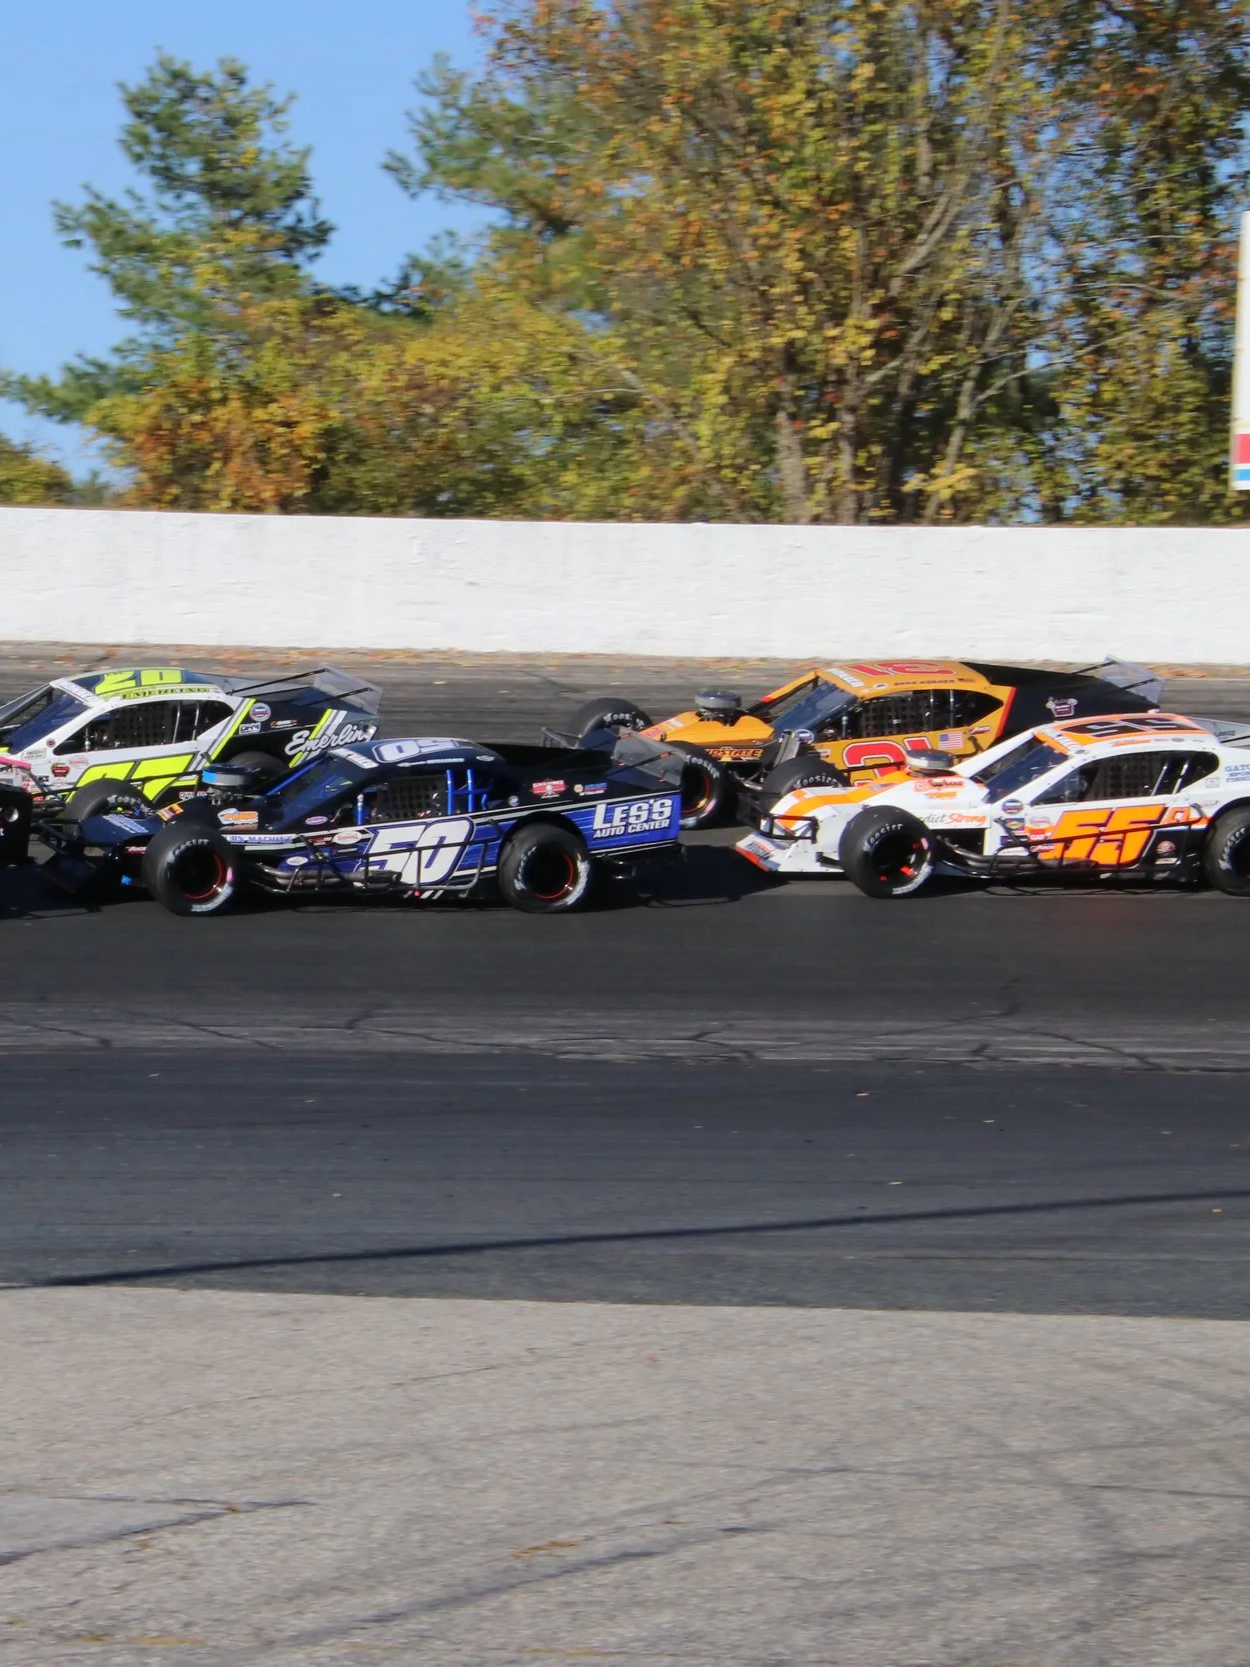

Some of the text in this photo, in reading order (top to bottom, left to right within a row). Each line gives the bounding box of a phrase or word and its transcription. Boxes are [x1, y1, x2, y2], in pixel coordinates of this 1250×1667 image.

[592, 818, 671, 839] AUTO CENTER
[360, 819, 473, 885] 50
